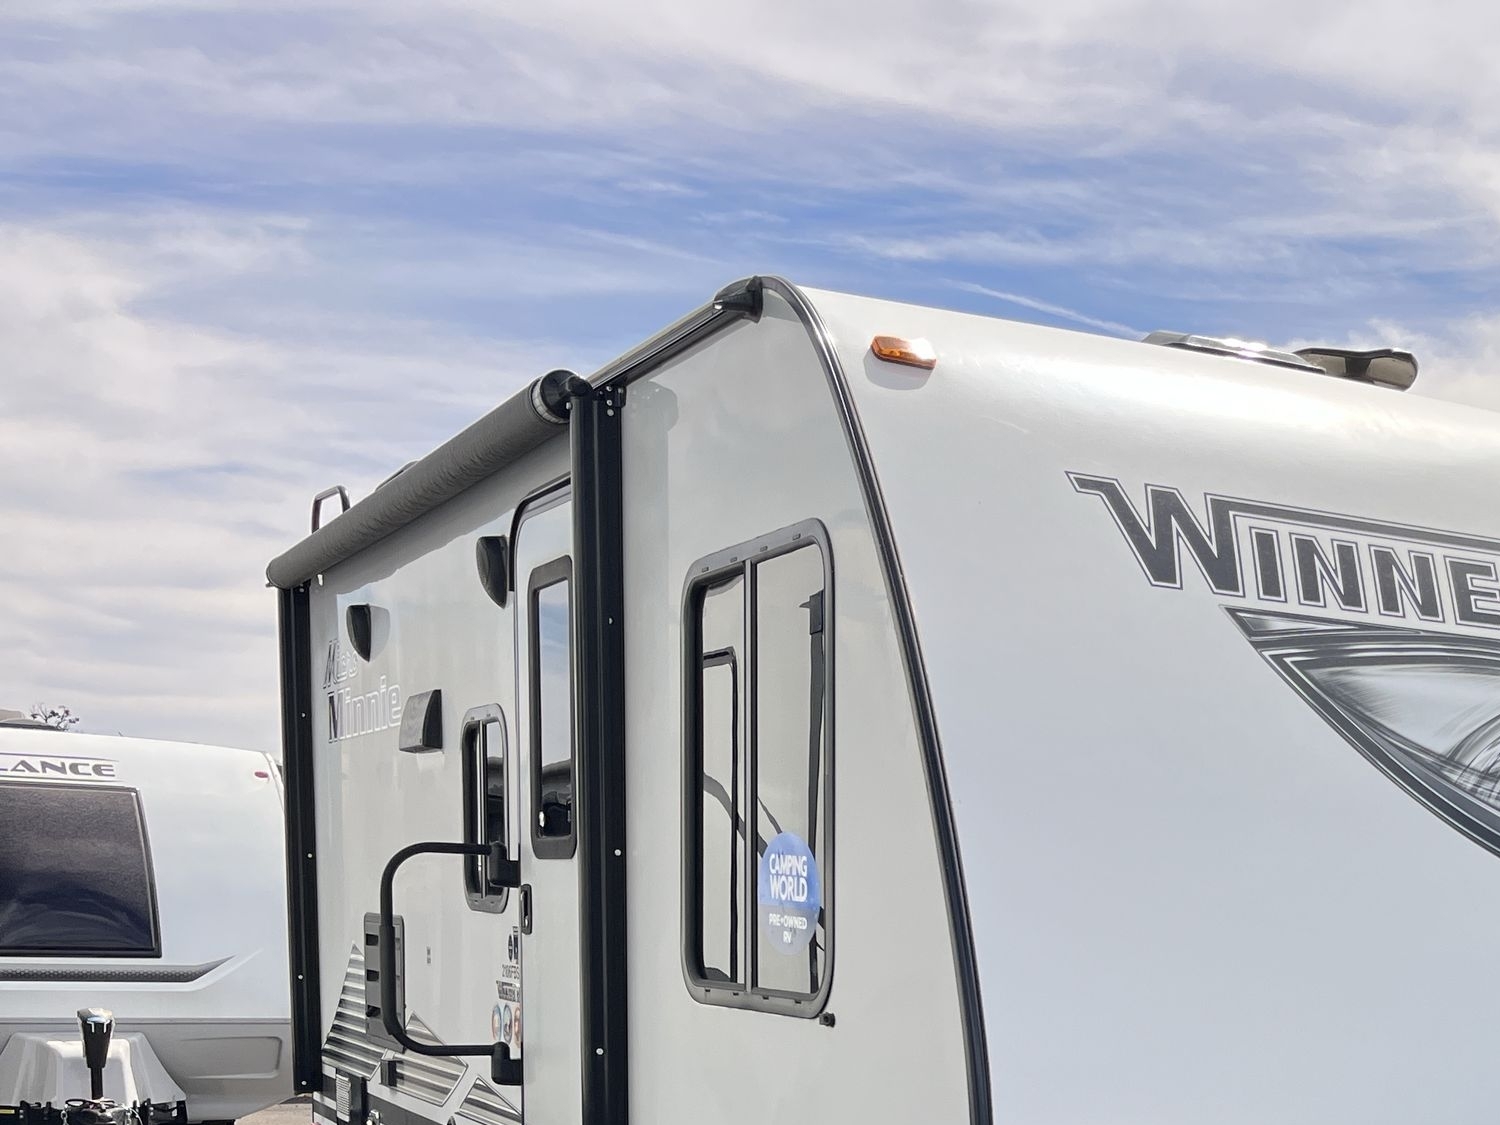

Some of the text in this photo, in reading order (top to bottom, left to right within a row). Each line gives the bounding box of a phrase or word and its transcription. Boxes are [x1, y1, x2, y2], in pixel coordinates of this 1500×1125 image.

[327, 674, 401, 744] Minnie
[0, 759, 116, 777] ANCE
[769, 853, 808, 877] CAMPING
[769, 874, 808, 903] WORLD
